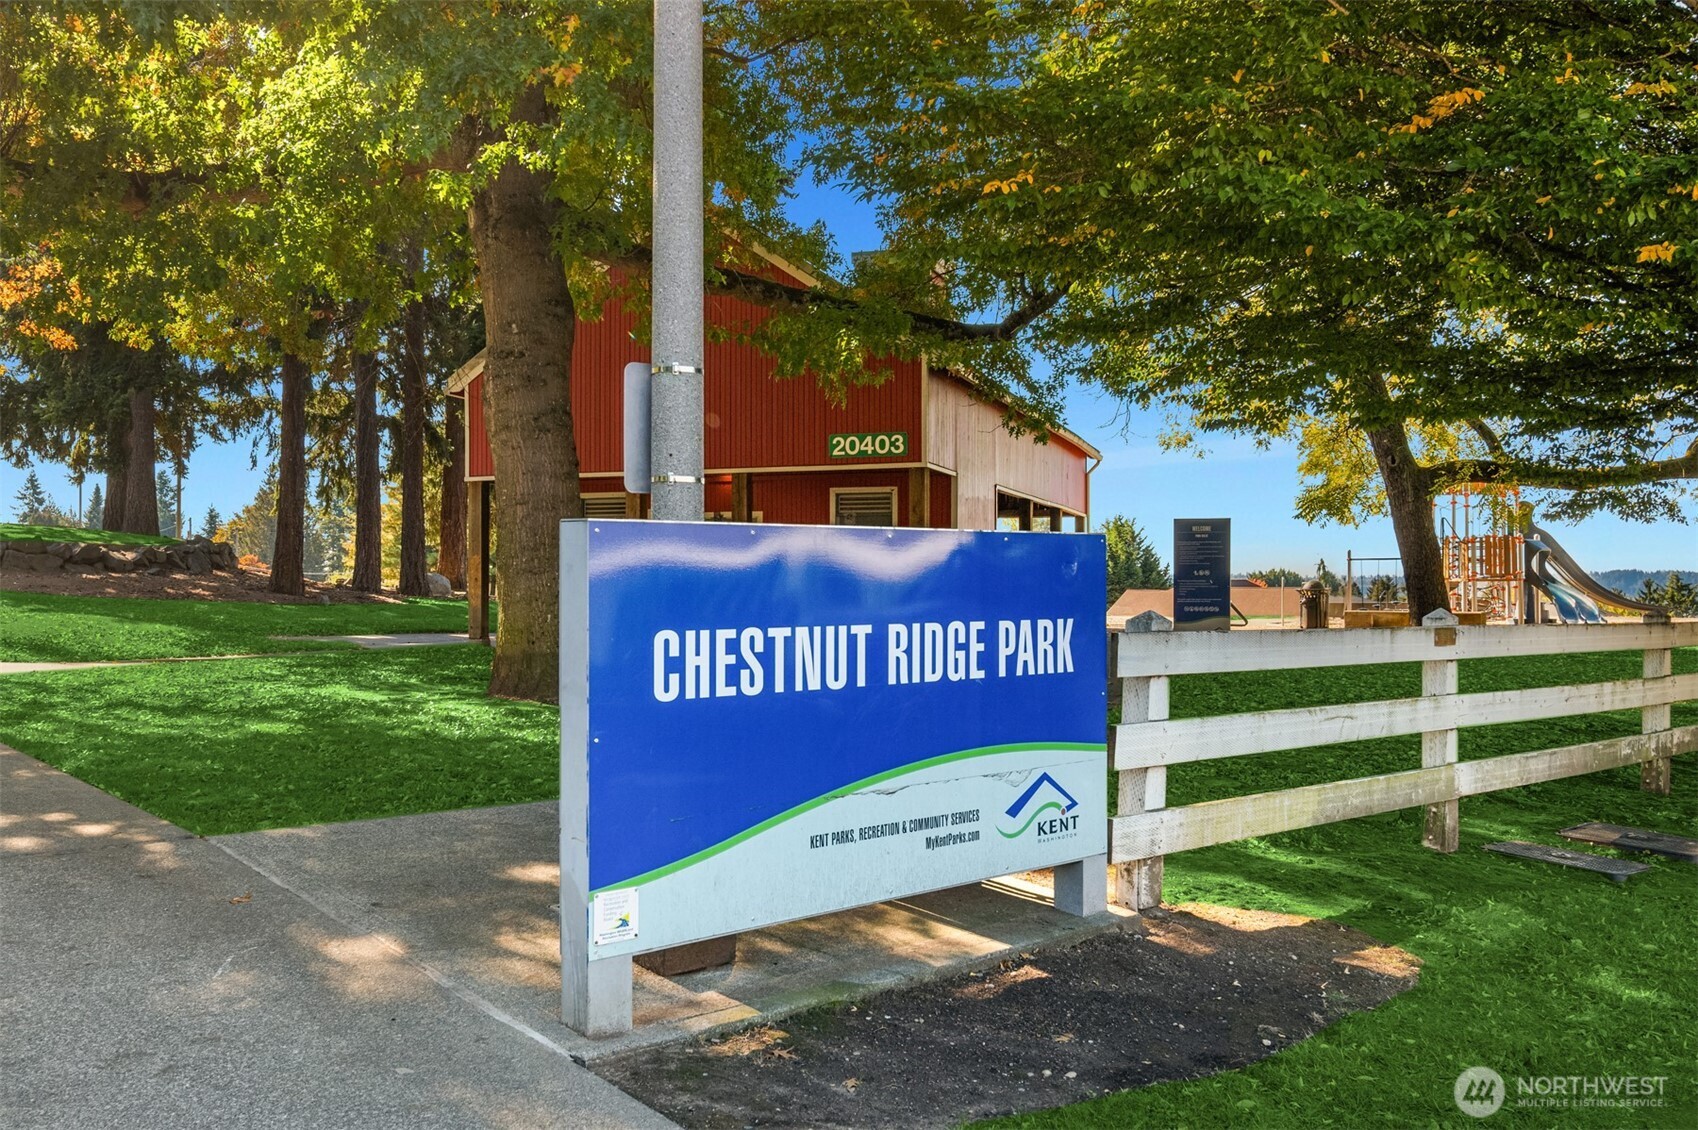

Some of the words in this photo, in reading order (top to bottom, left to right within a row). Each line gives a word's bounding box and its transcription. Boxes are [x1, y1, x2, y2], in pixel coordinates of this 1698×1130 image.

[832, 434, 904, 456] 20403
[653, 623, 873, 702] CHESTNUT
[887, 620, 985, 685] RIDGE
[998, 618, 1075, 677] PARK
[810, 833, 829, 849] KENT
[831, 828, 857, 845] PARKS,
[858, 821, 900, 841] RECREATION
[902, 820, 907, 833] &
[908, 814, 949, 833] COMMUNITY
[950, 808, 980, 826] SERVICES
[1037, 815, 1079, 836] KENT
[925, 830, 980, 850] MyKentParks.com
[1037, 833, 1077, 844] WASHINGTON
